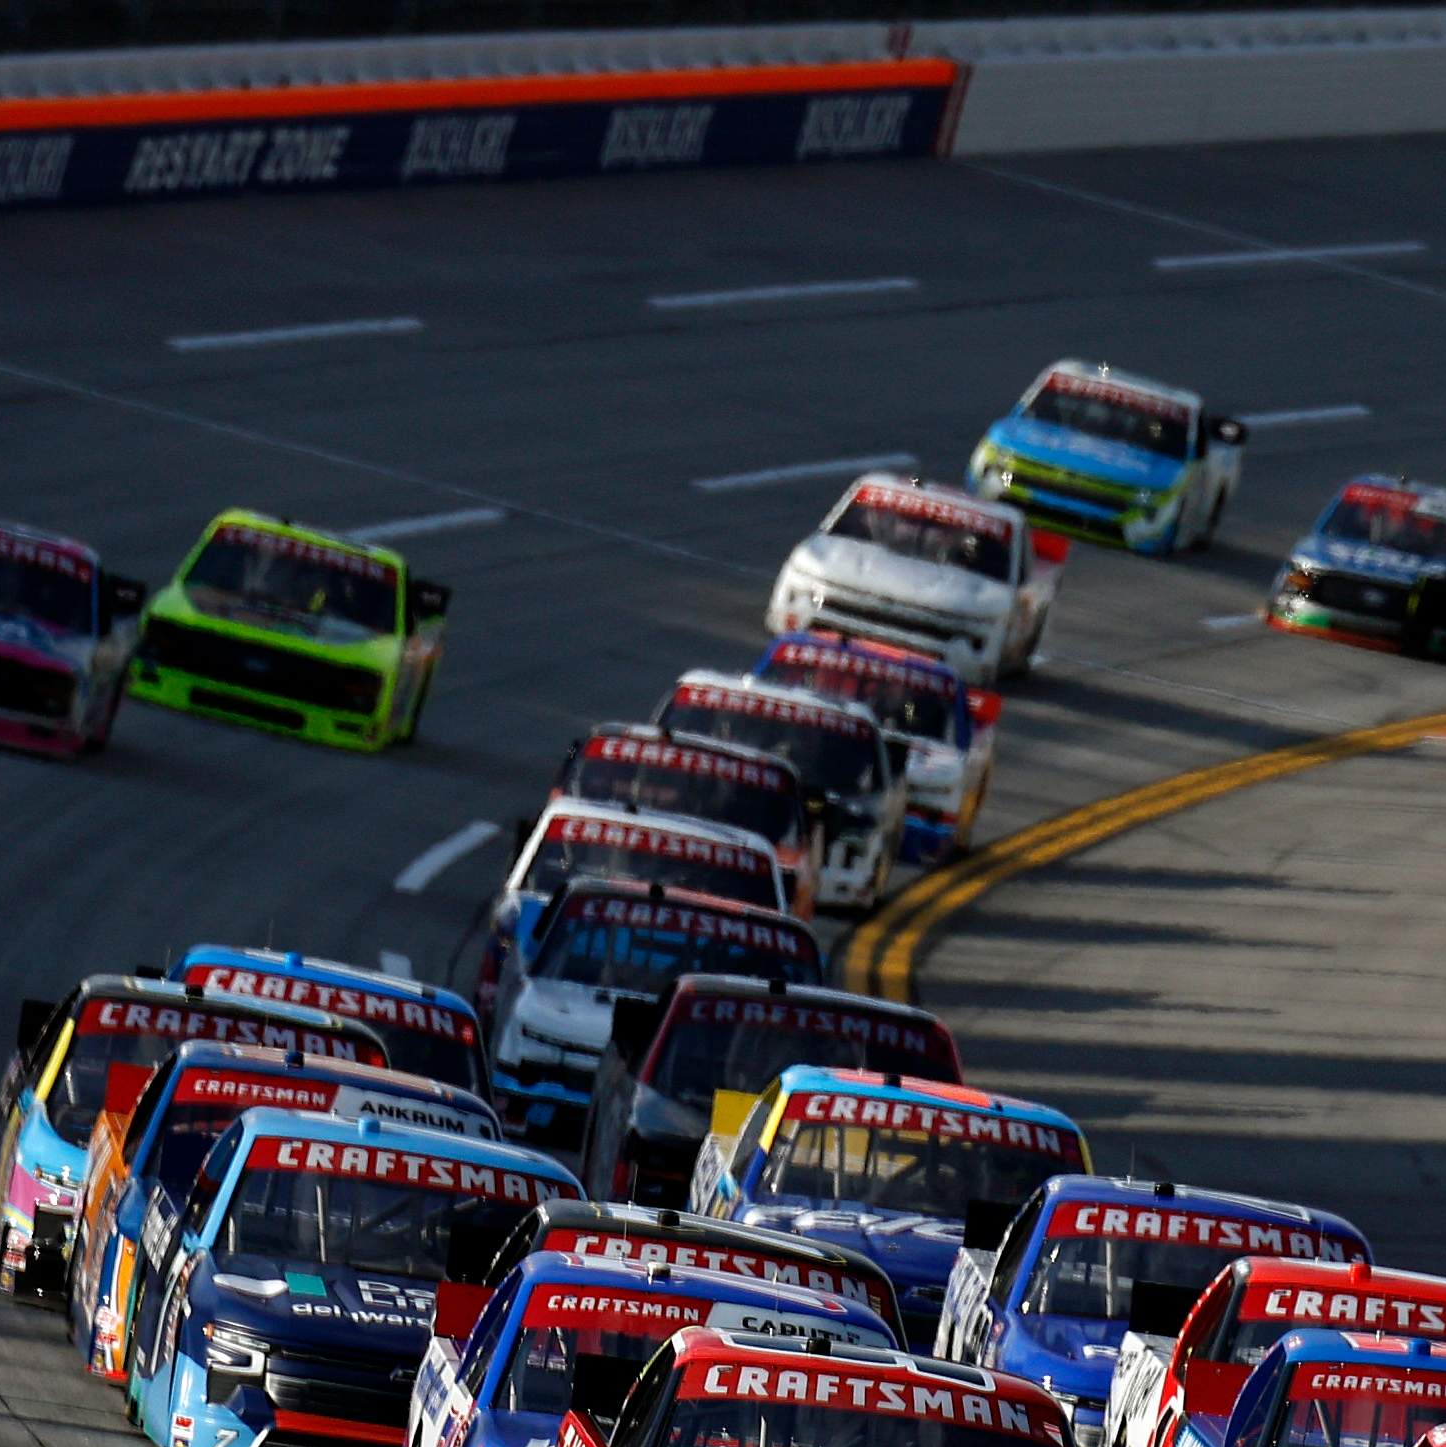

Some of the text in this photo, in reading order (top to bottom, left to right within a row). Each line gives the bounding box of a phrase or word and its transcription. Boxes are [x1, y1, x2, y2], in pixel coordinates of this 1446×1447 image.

[259, 125, 353, 182] ZONE
[562, 819, 757, 872] CRAFTSMAN
[583, 899, 801, 953] CRAFTSMAN
[100, 1002, 354, 1061] CRAFTSMAN
[205, 969, 454, 1037] CRAFTSMAN
[691, 999, 927, 1052] CRAFTSMAN
[194, 1078, 465, 1133] CRAFTSMAN ANKRUM
[806, 1094, 1060, 1155] CRAFTSMAN
[277, 1140, 560, 1202] CRAFTSMAN
[1076, 1206, 1346, 1263] CRAFTSMAN
[575, 1234, 869, 1304] CRAFTSMAN
[548, 1295, 699, 1322] CRAFTSMAN
[704, 1365, 1031, 1433] CRAFTSMAN
